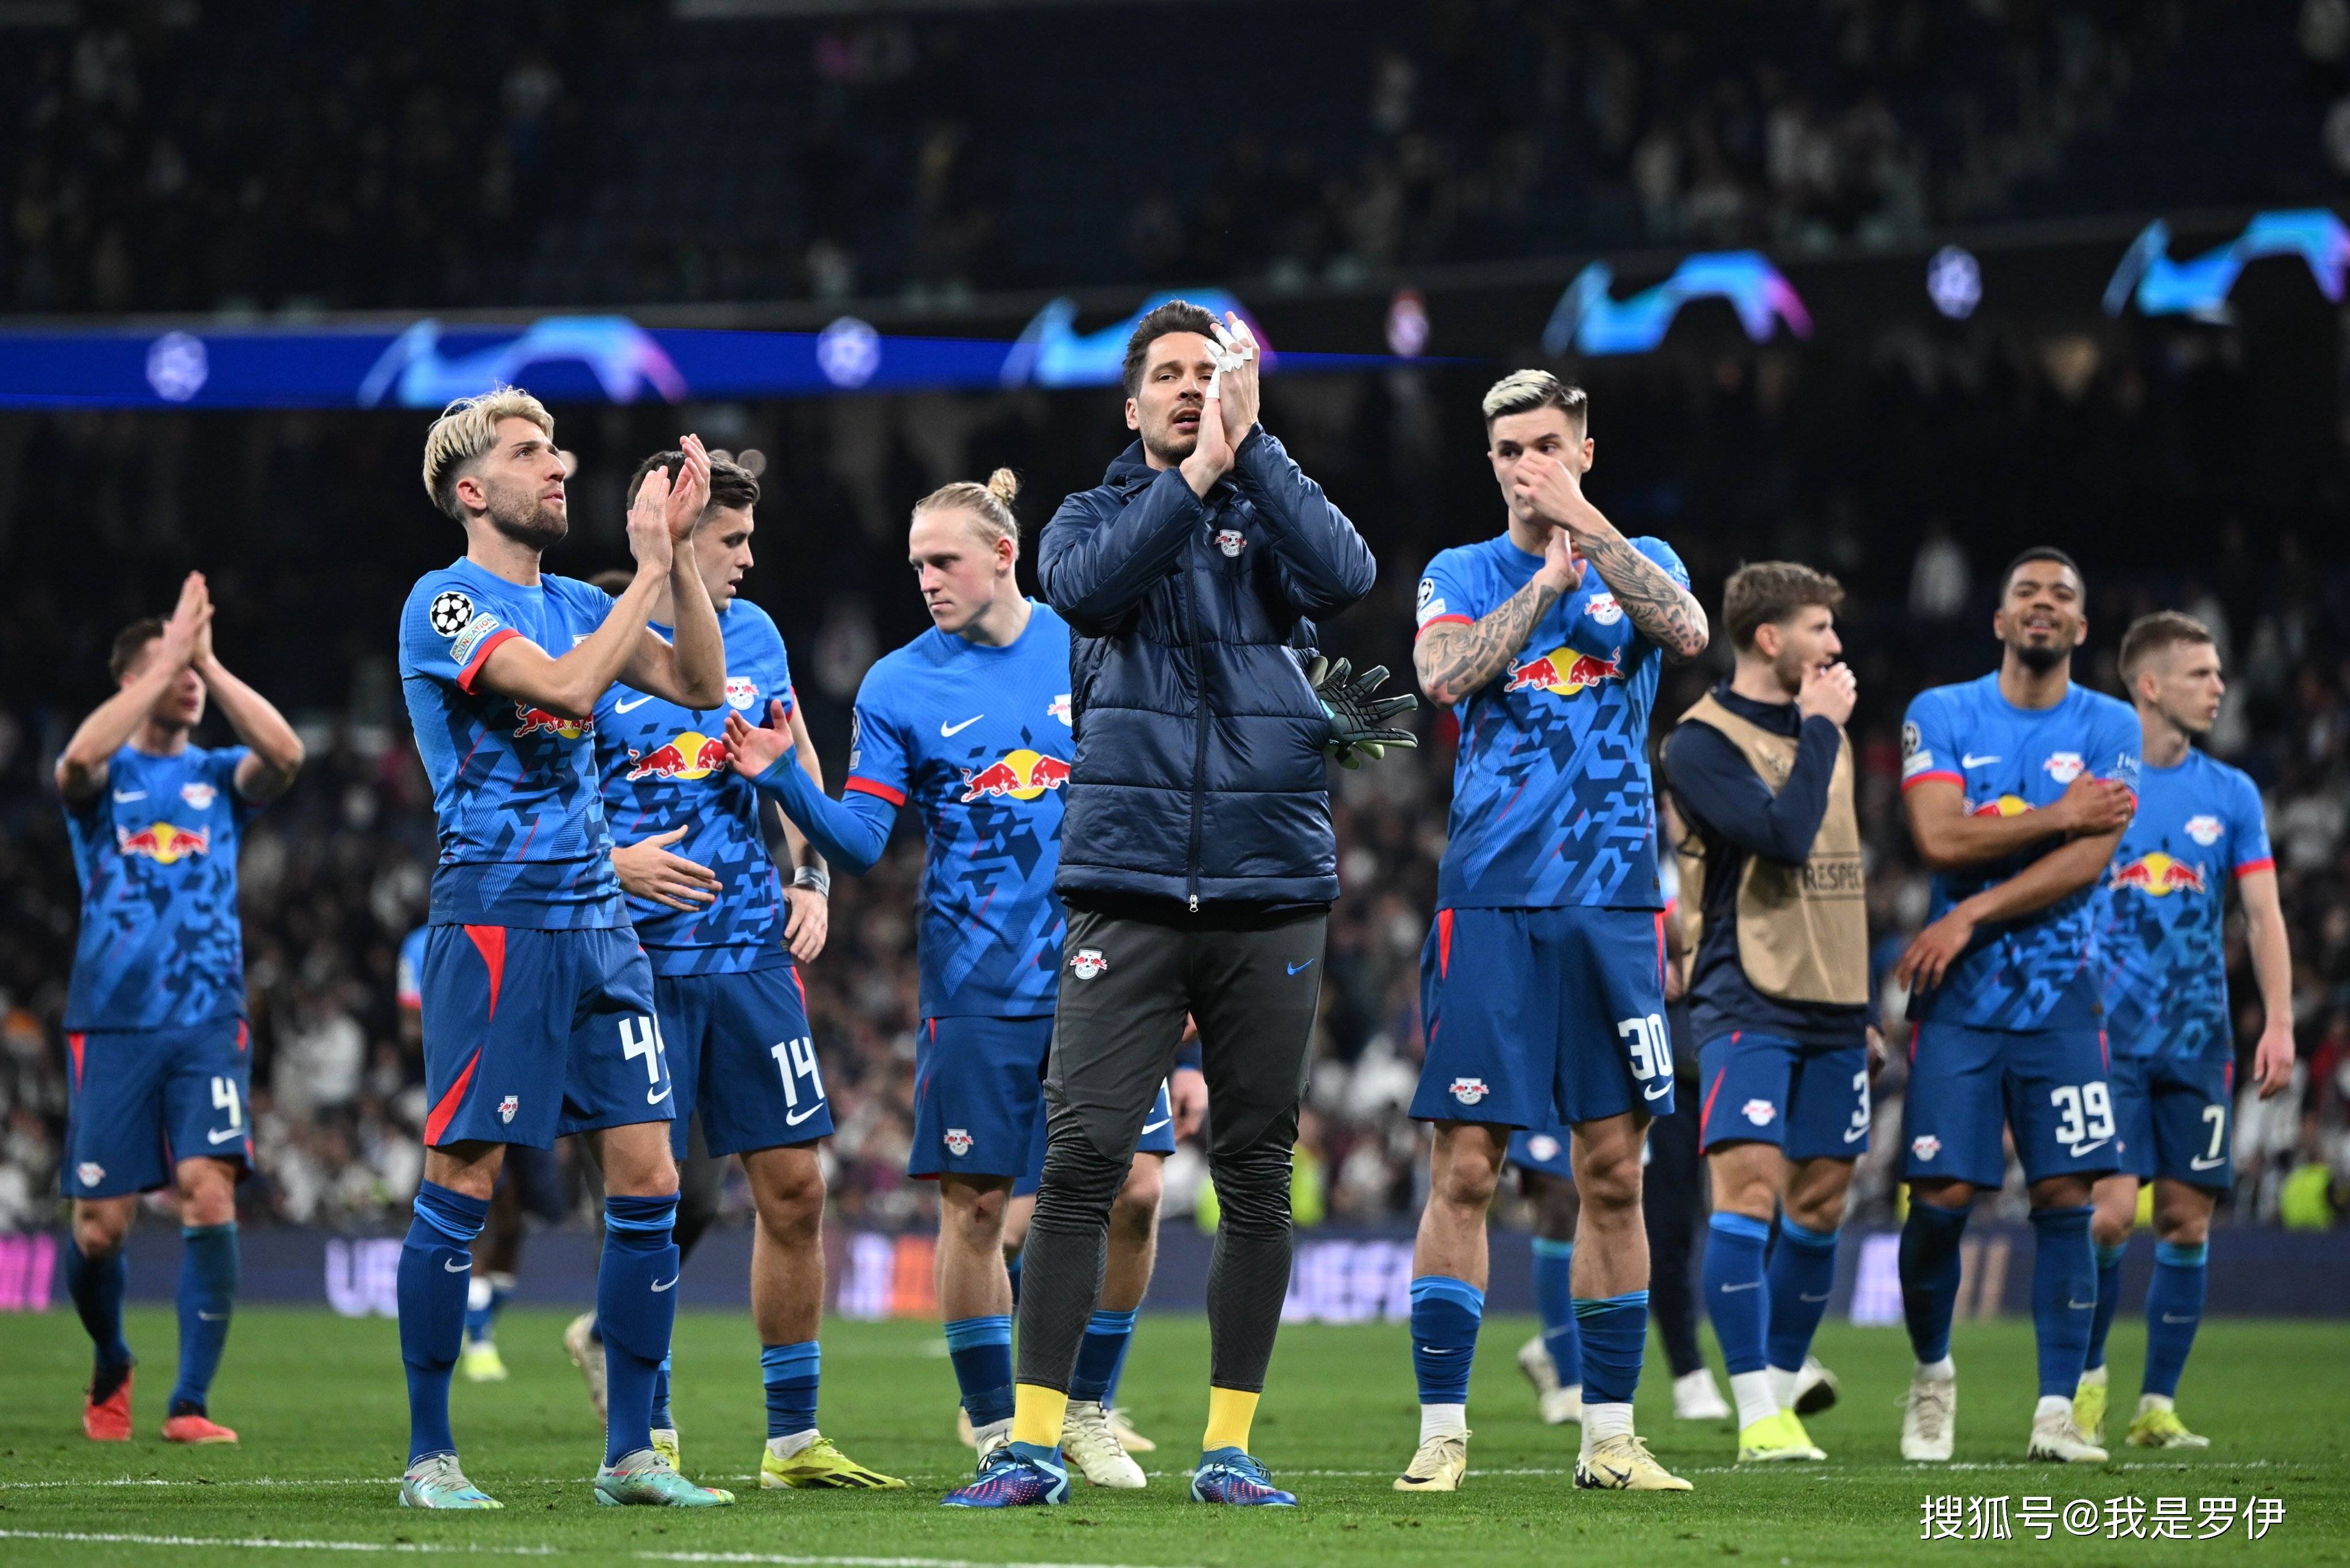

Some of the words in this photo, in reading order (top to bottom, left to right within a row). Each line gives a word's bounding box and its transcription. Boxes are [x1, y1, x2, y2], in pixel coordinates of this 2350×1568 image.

[453, 617, 494, 661] FOUNDATION
[771, 1037, 825, 1108] 14
[1617, 1014, 1673, 1081] 30
[211, 1076, 242, 1129] 4
[2050, 1081, 2116, 1143] 39
[2202, 1104, 2226, 1159] 7
